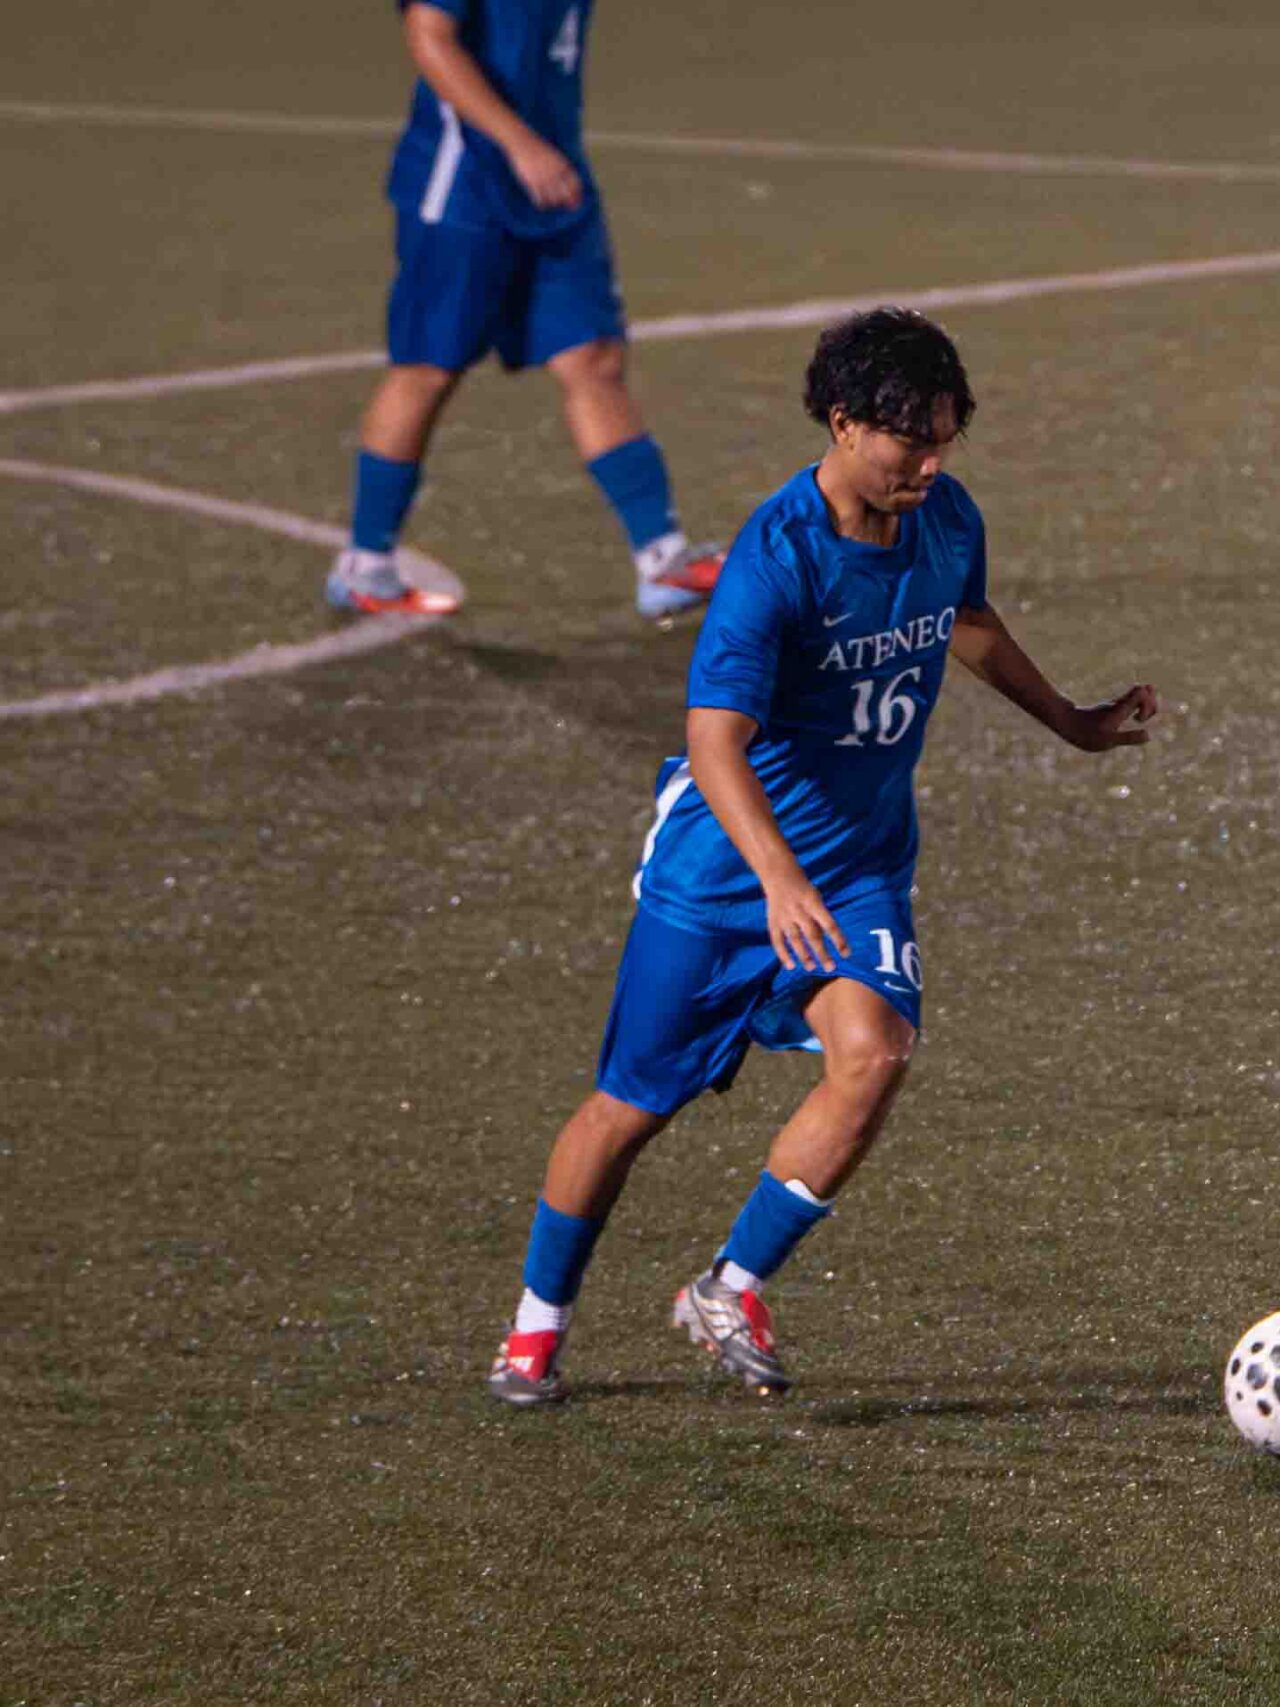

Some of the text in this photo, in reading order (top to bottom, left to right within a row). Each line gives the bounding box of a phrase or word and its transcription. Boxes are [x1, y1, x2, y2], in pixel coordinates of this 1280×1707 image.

[548, 3, 579, 75] 4
[817, 606, 956, 671] ATENEO
[834, 666, 921, 747] 16
